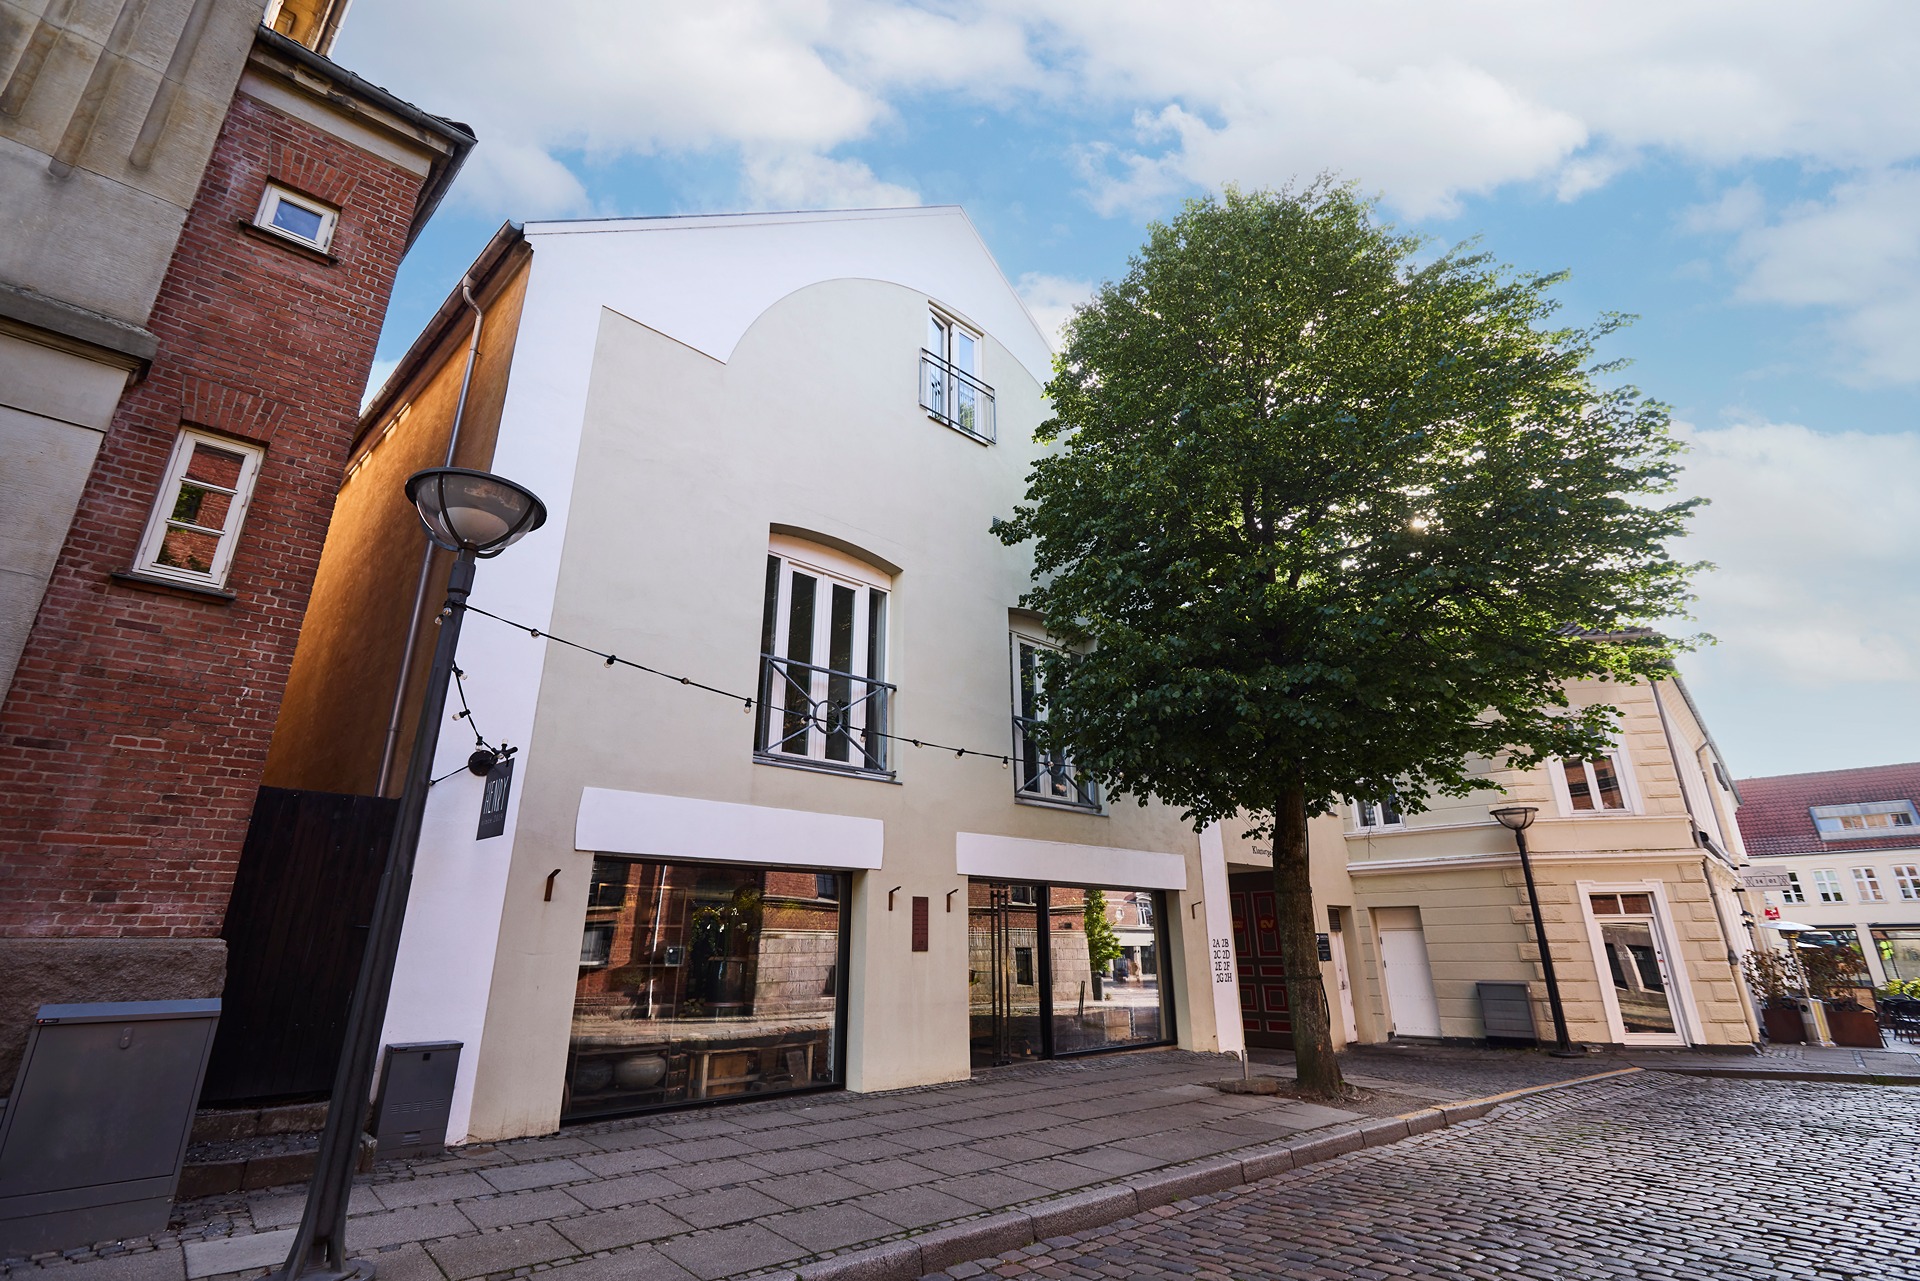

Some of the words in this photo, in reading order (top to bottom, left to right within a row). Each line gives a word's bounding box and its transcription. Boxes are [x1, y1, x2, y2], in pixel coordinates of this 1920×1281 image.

[483, 775, 510, 815] HENRY
[1212, 938, 1220, 948] 2A
[1221, 938, 1229, 948] 2B
[1213, 949, 1221, 959] 2C
[1222, 949, 1230, 959] 2D
[1215, 961, 1222, 971] 2E
[1223, 961, 1230, 971] 2F
[1216, 972, 1224, 983] 2G
[1224, 972, 1232, 983] 2H
